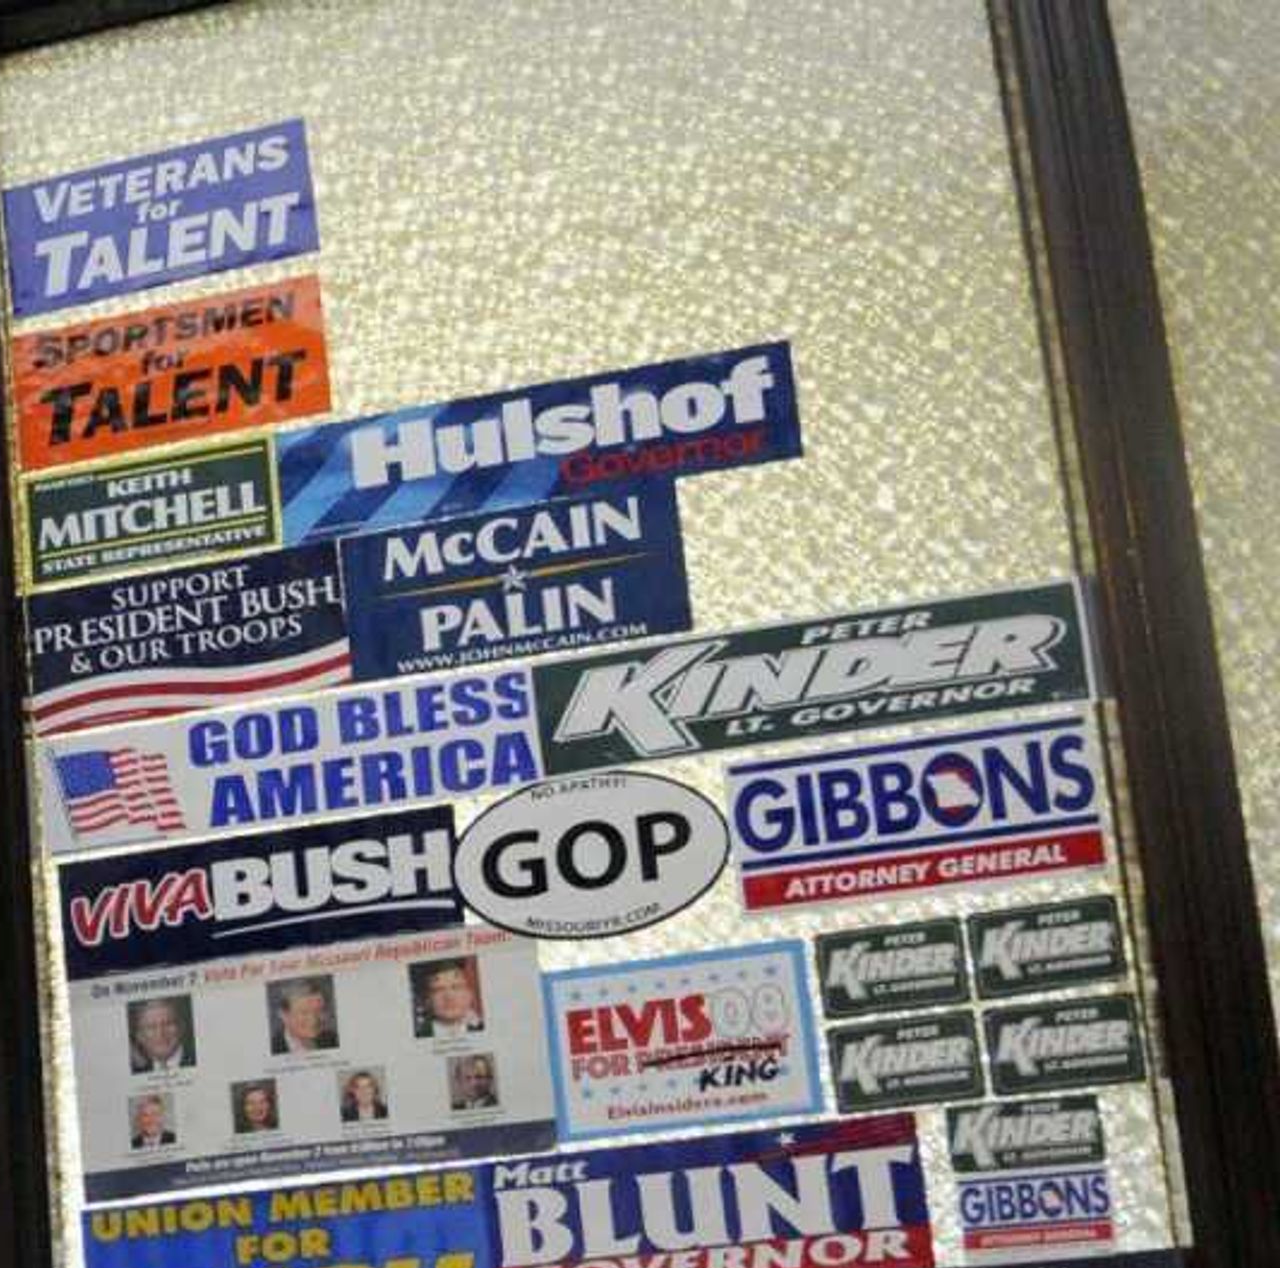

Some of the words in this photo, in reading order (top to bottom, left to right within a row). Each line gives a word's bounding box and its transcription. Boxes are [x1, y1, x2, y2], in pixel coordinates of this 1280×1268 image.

[33, 134, 288, 223] VETERANS
[138, 198, 182, 222] for
[36, 192, 300, 297] TALENT
[32, 291, 294, 370] SPORTSMEN
[39, 349, 307, 446] TALENT
[351, 355, 775, 489] Hulshof
[108, 469, 191, 497] KEITH
[560, 427, 765, 487] Governor
[40, 482, 266, 550] MITCHELL
[42, 553, 95, 573] STATE
[101, 525, 266, 564] REPRESENTATIVE
[383, 497, 641, 582] McCAIN
[34, 595, 228, 653] PRESIDENT
[241, 576, 342, 618] BUSH
[112, 566, 249, 609] SUPPORT
[420, 578, 615, 651] PALIN
[100, 639, 170, 667] OUR
[179, 614, 302, 654] TROOPS
[801, 610, 935, 647] PETER
[188, 705, 318, 769] GOD
[340, 672, 529, 743] BLESS
[725, 710, 785, 738] LT.
[791, 677, 1036, 730] GOVERNOR
[210, 731, 539, 829] AMERICA
[735, 732, 1096, 856] GIBBONS
[71, 869, 209, 946] VIVA
[211, 827, 453, 922] BUSH
[481, 811, 692, 899] GOP
[784, 858, 930, 900] ATTORNEY
[937, 841, 1068, 881] GENERAL
[565, 993, 712, 1055] ELVIS
[571, 1051, 633, 1081] FOR
[700, 1056, 779, 1092] KING
[91, 1199, 253, 1240] UNION
[271, 1171, 476, 1223] MEMBER
[492, 1159, 588, 1190] Matt
[493, 1145, 916, 1268] BLUNT
[959, 1176, 1110, 1225] GIBBONS
[236, 1228, 331, 1264] FOR
